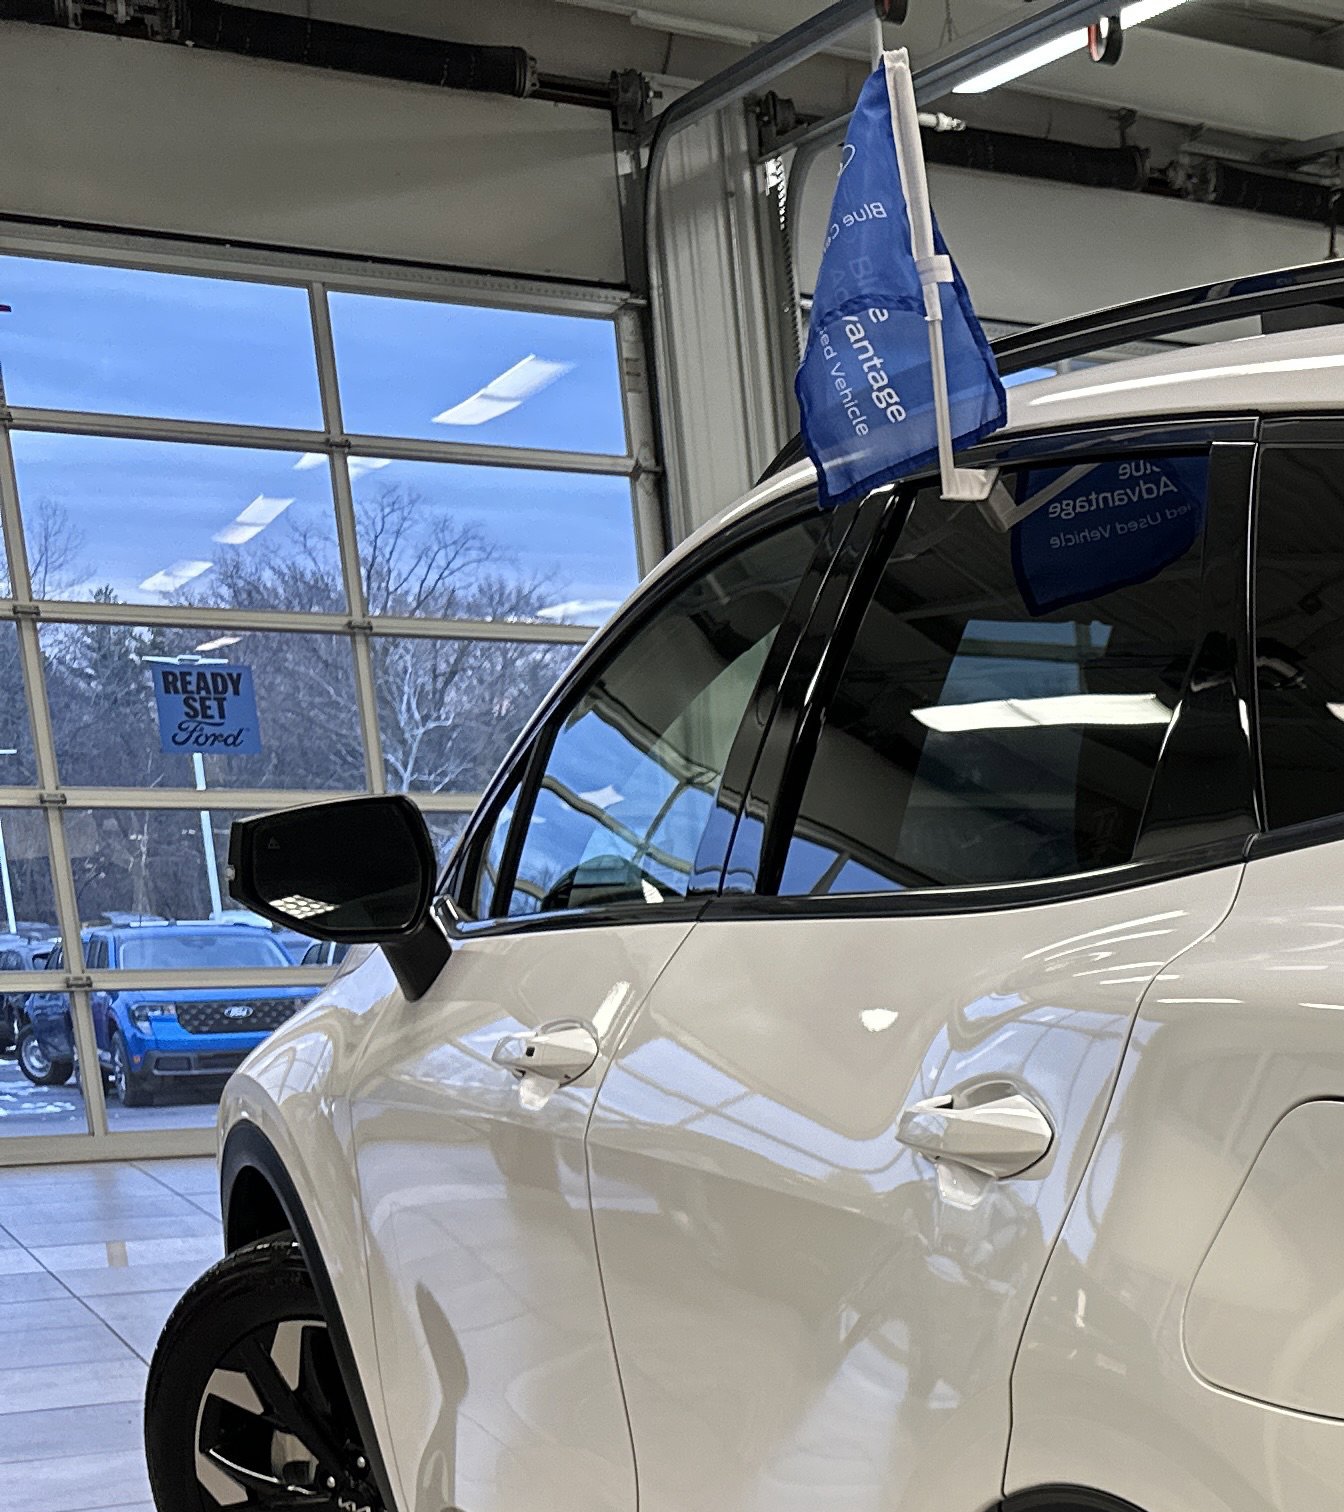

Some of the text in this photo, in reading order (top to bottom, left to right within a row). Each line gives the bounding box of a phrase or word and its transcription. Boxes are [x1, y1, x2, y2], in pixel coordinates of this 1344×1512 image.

[831, 362, 869, 437] Vehicle
[161, 670, 242, 696] READY
[182, 695, 227, 720] SET
[171, 720, 245, 748] Ford
